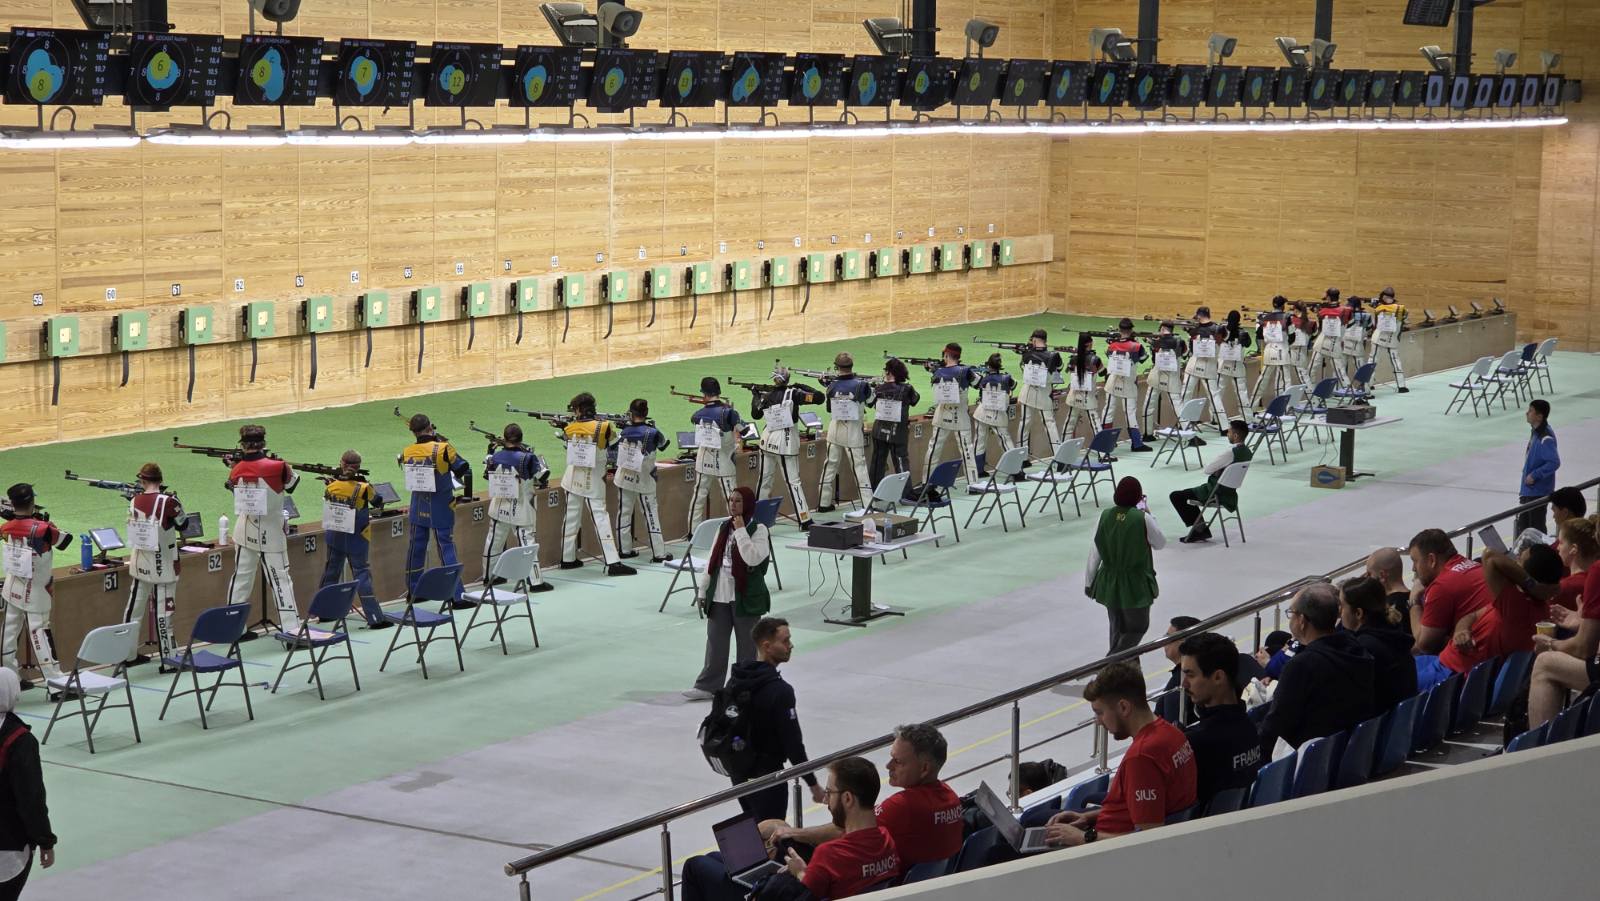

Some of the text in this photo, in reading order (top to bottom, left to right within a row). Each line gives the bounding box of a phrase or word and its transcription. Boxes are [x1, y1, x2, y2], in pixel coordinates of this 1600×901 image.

[44, 40, 50, 50] 8
[10, 64, 15, 74] 7
[130, 67, 135, 76] 7
[158, 60, 164, 71] 6
[259, 66, 265, 78] 8
[38, 79, 44, 91] 8
[550, 492, 559, 505] 56
[473, 507, 484, 521] 55
[393, 520, 403, 535] 54
[305, 536, 316, 552] 53
[209, 554, 221, 569] 52
[105, 574, 117, 590] 51
[1172, 740, 1193, 768] FRANC
[1233, 744, 1260, 768] FRANC
[1136, 789, 1157, 802] SIUS
